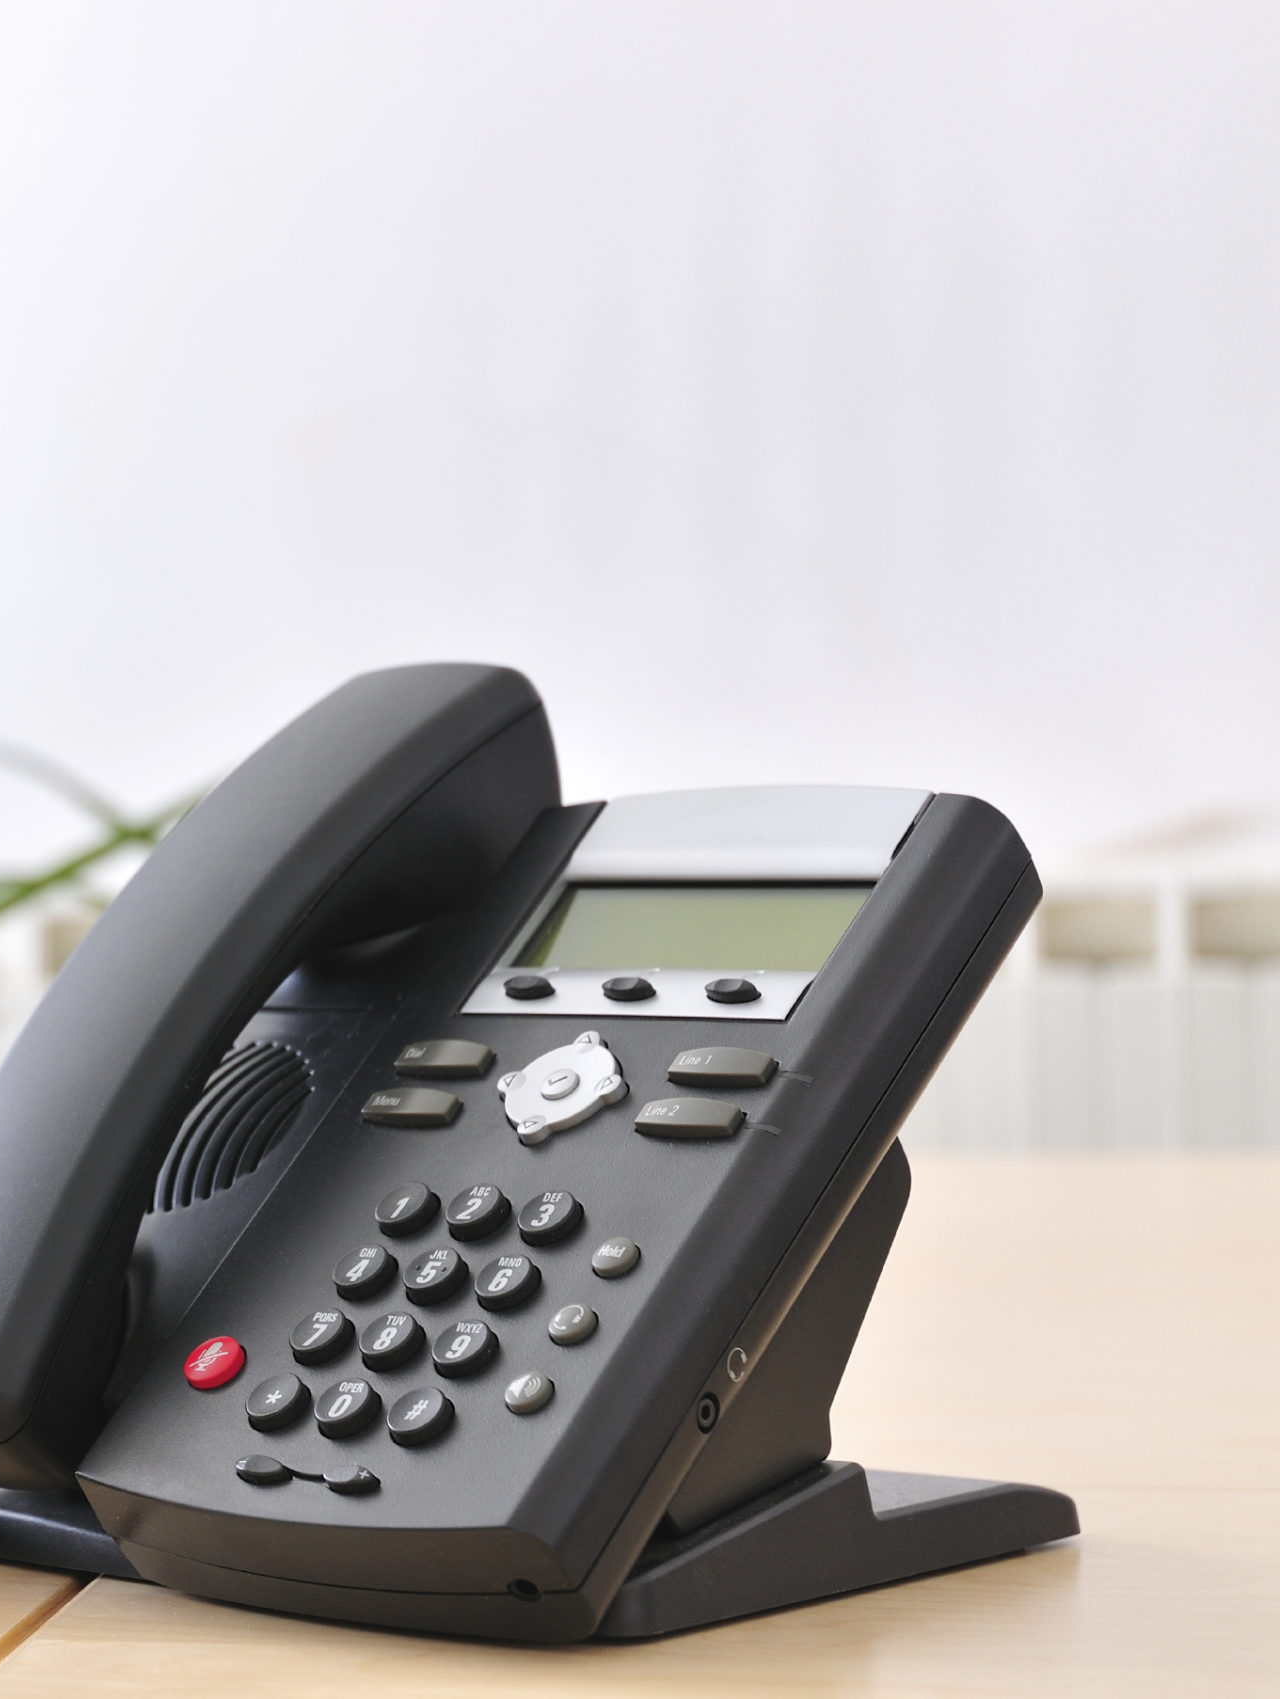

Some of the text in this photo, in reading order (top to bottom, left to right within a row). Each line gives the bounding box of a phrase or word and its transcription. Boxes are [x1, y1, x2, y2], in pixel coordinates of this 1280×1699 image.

[679, 1054, 713, 1065] Line 1
[644, 1104, 680, 1117] Line 2
[470, 1186, 491, 1197] ABC
[542, 1192, 564, 1203] DEF
[390, 1197, 410, 1219] 1
[455, 1198, 482, 1220] 2
[530, 1203, 556, 1227] 3
[359, 1247, 378, 1258] GHI
[429, 1249, 449, 1260] JKL
[597, 1244, 626, 1258] Hold
[345, 1259, 370, 1282] 4
[498, 1256, 523, 1267] MNO
[415, 1261, 441, 1284] 5
[487, 1268, 513, 1292] 6
[386, 1315, 408, 1326] TUV
[455, 1322, 484, 1334] WXYZ
[301, 1323, 328, 1346] 7
[372, 1326, 398, 1350] 8
[444, 1334, 472, 1359] 9
[338, 1381, 365, 1393] OPER
[327, 1394, 353, 1418] 0
[403, 1399, 430, 1421] #
